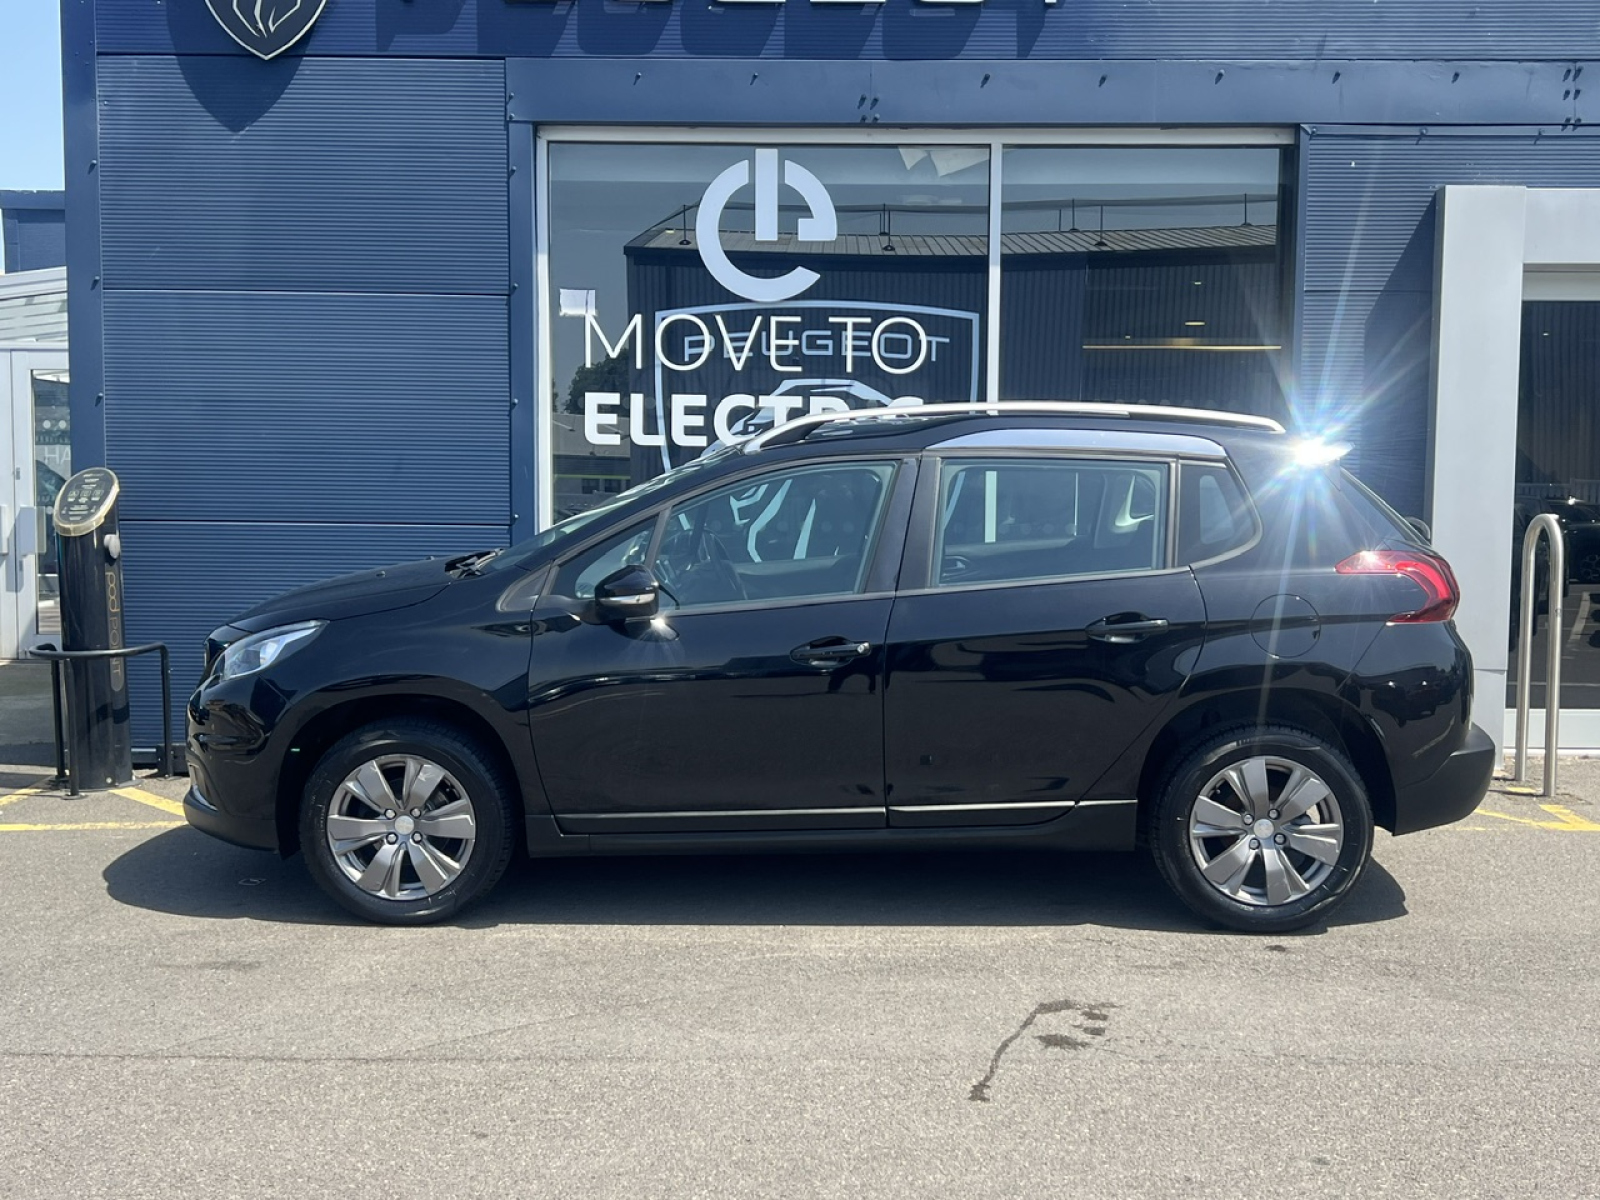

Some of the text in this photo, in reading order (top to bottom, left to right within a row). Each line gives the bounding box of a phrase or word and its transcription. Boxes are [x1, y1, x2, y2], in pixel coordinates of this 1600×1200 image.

[584, 313, 928, 375] MOVE TO
[683, 329, 950, 362] PEUGEOT
[105, 571, 120, 612] pod
